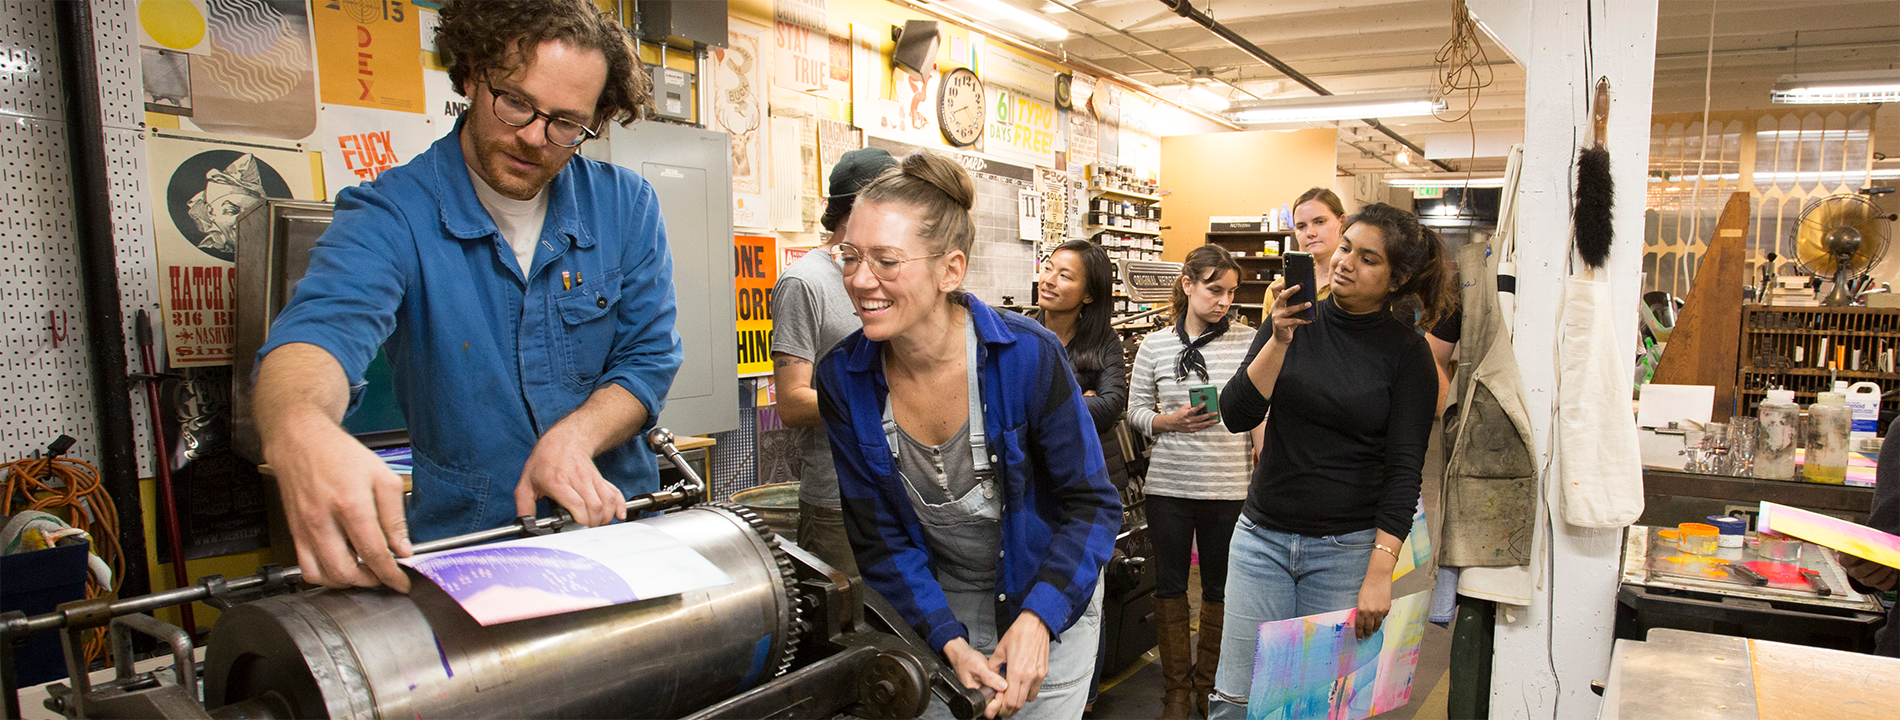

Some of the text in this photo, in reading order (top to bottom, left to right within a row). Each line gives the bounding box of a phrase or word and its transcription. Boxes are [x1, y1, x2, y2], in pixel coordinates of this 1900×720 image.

[777, 20, 809, 55] STAY
[793, 54, 829, 89] TRUE
[728, 82, 749, 102] BUCK
[1018, 98, 1052, 130] TYPO
[990, 124, 1011, 143] DAYS
[1014, 123, 1053, 155] FREE!
[338, 131, 399, 170] FUCK
[1024, 196, 1036, 218] 11
[1046, 191, 1063, 202] SOLO
[169, 265, 224, 310] HATCH
[172, 311, 203, 326] 316
[760, 409, 787, 431] WA
